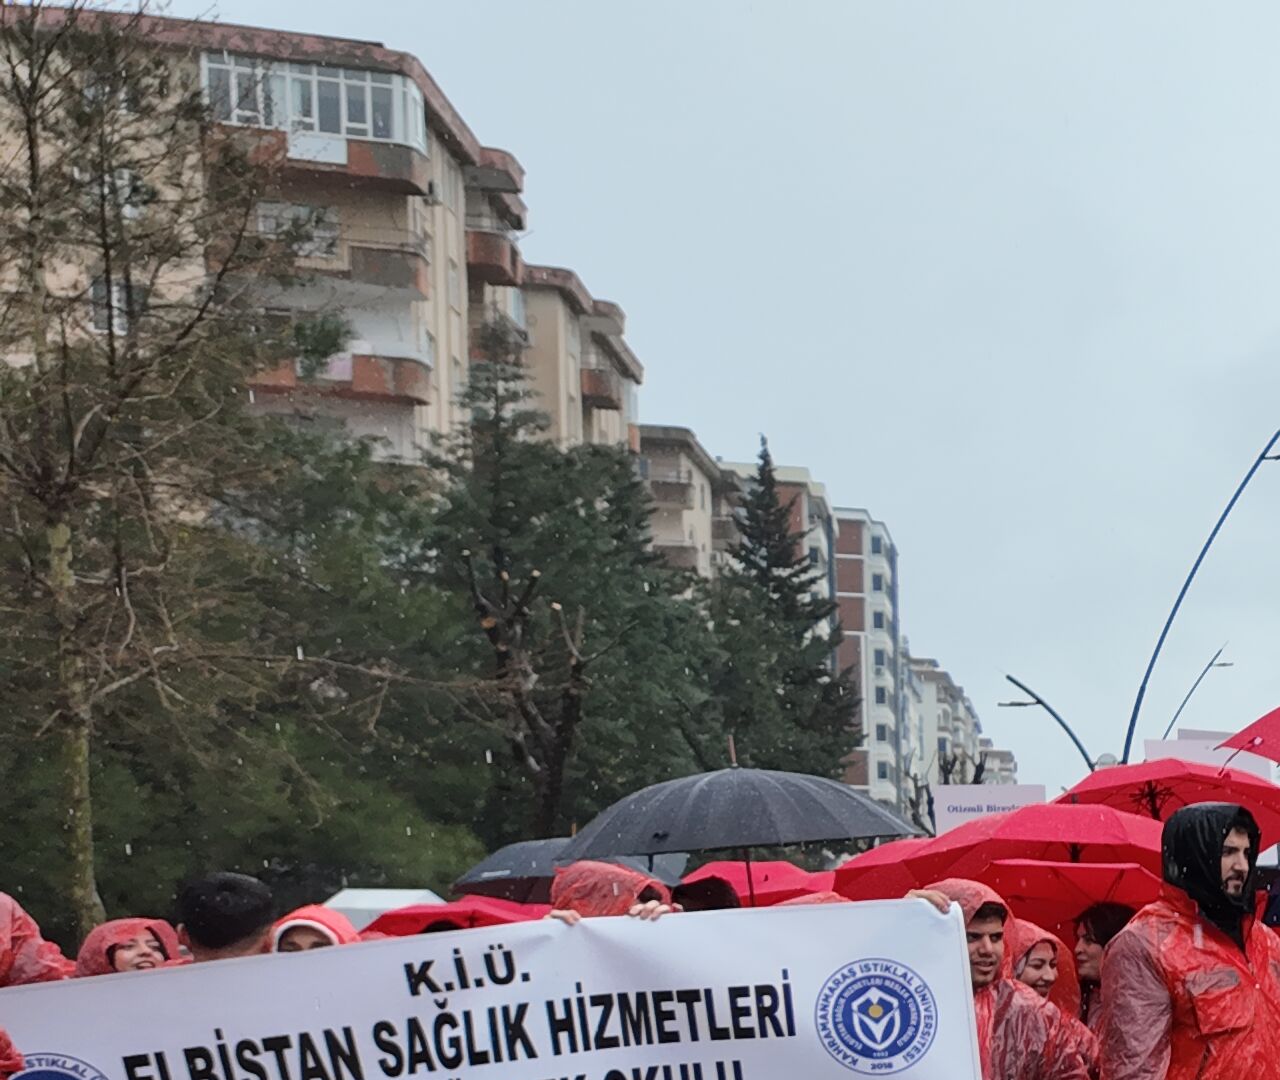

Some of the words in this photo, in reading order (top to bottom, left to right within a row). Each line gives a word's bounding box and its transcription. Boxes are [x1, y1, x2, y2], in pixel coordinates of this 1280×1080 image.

[403, 943, 531, 997] K.İ.Ü.
[372, 998, 538, 1078] SAĞLIK
[545, 968, 797, 1057] HİZMETLERİ
[25, 1057, 88, 1079] STİKLAL
